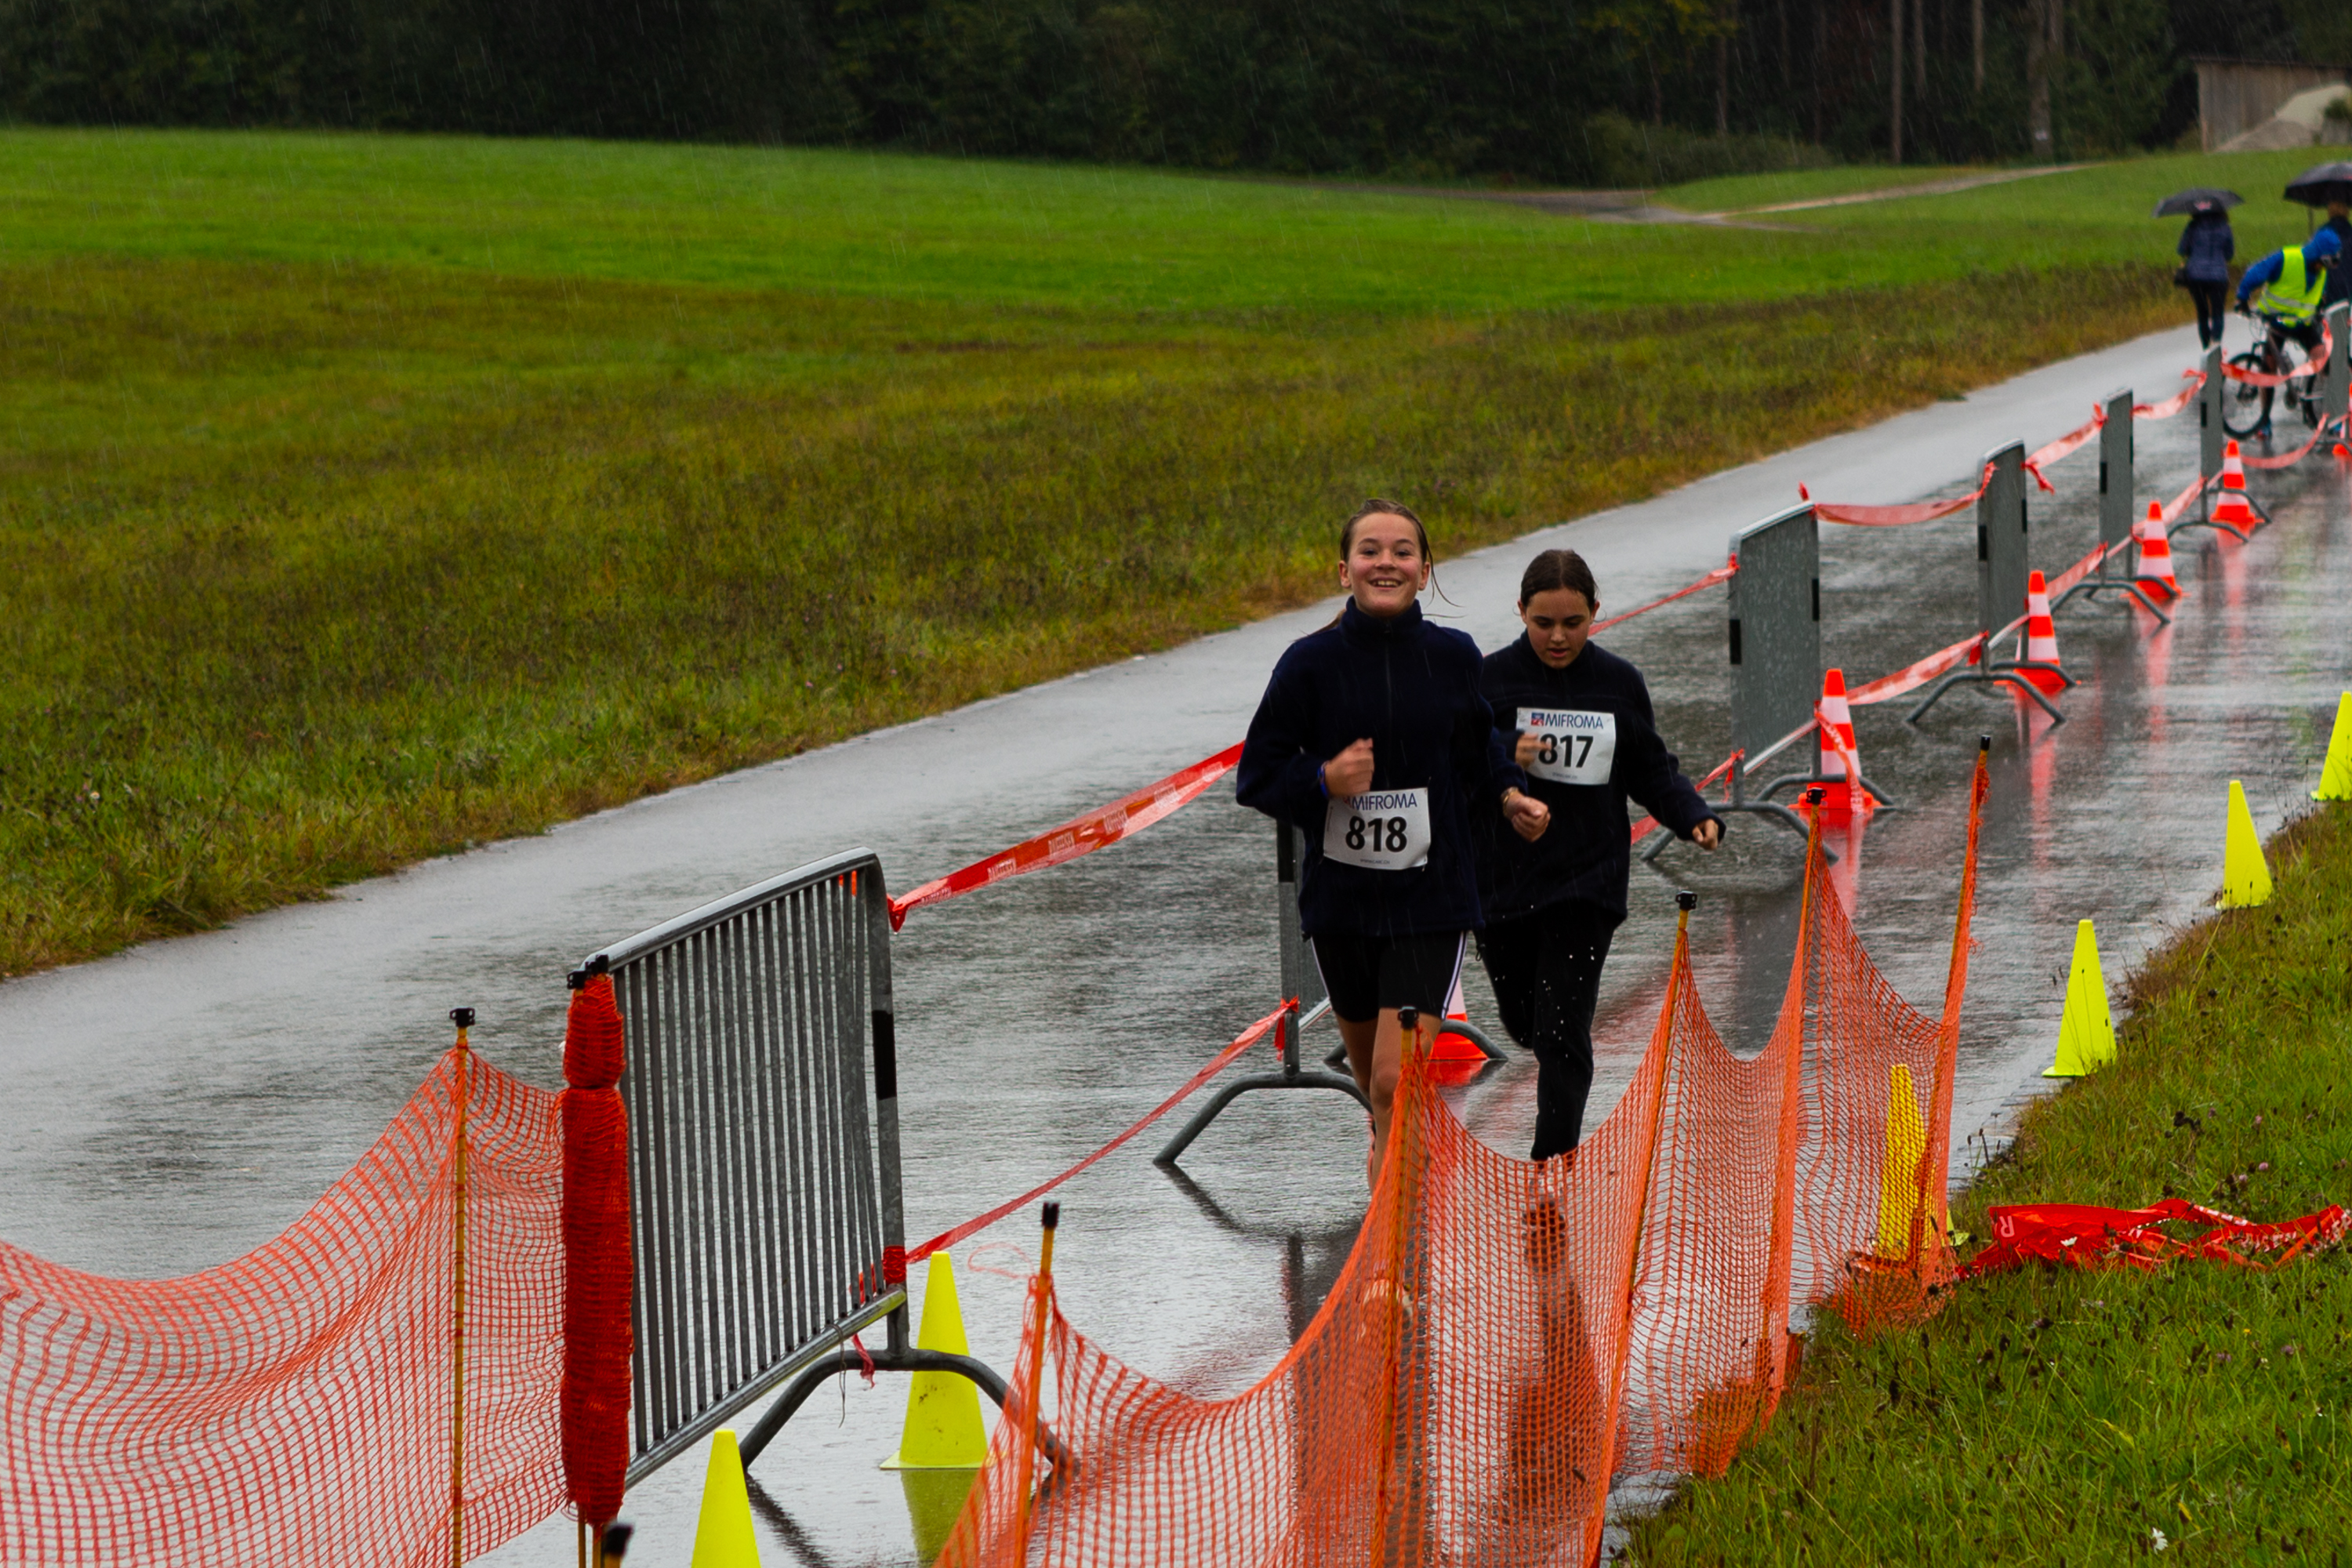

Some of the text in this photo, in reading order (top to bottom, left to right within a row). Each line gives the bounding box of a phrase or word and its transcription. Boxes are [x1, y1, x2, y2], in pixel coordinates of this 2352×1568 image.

[1544, 713, 1604, 730] MIFROMA
[1538, 733, 1594, 768] 817
[1352, 793, 1417, 811] MIFROMA
[1345, 815, 1407, 853] 818
